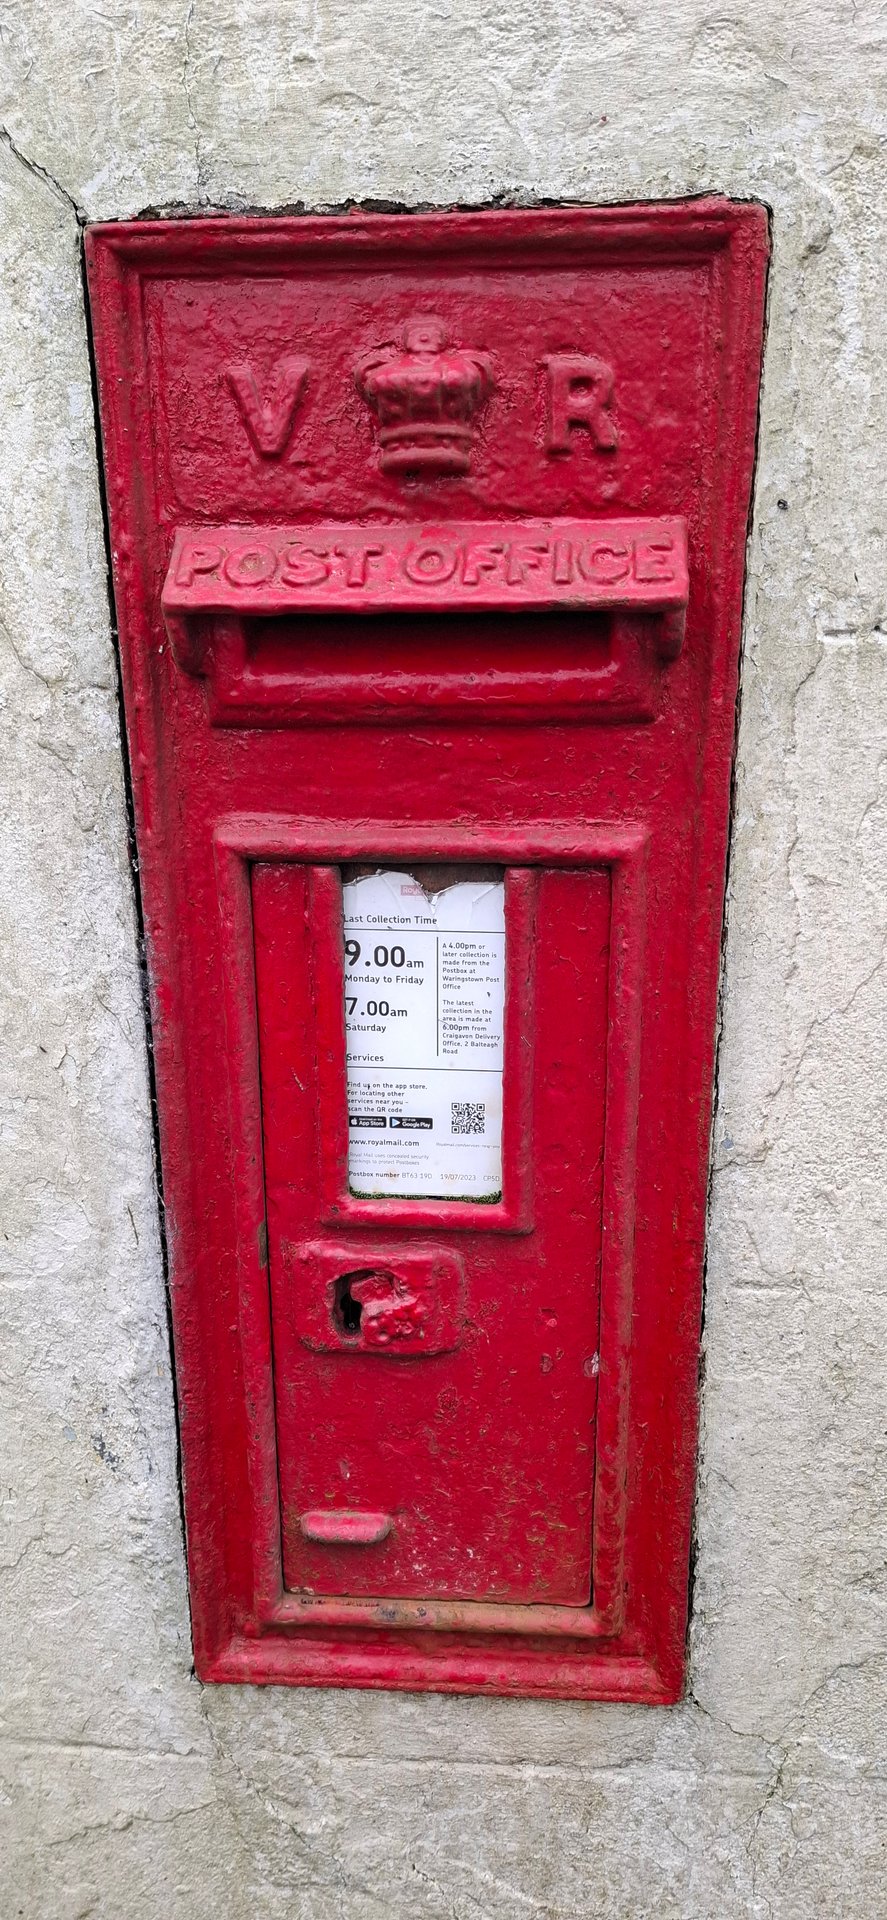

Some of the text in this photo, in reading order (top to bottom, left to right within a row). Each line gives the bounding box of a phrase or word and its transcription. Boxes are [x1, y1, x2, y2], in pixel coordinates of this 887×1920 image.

[228, 353, 618, 455] V R
[175, 538, 673, 587] POST OFFICE
[367, 915, 411, 923] Collection
[414, 916, 437, 924] Time
[345, 940, 424, 968] 9.00am
[345, 975, 380, 984] Monday
[396, 976, 424, 985] Friday
[345, 997, 407, 1017] 7.00am
[346, 1023, 386, 1032] Saturday
[347, 1054, 384, 1062] Services
